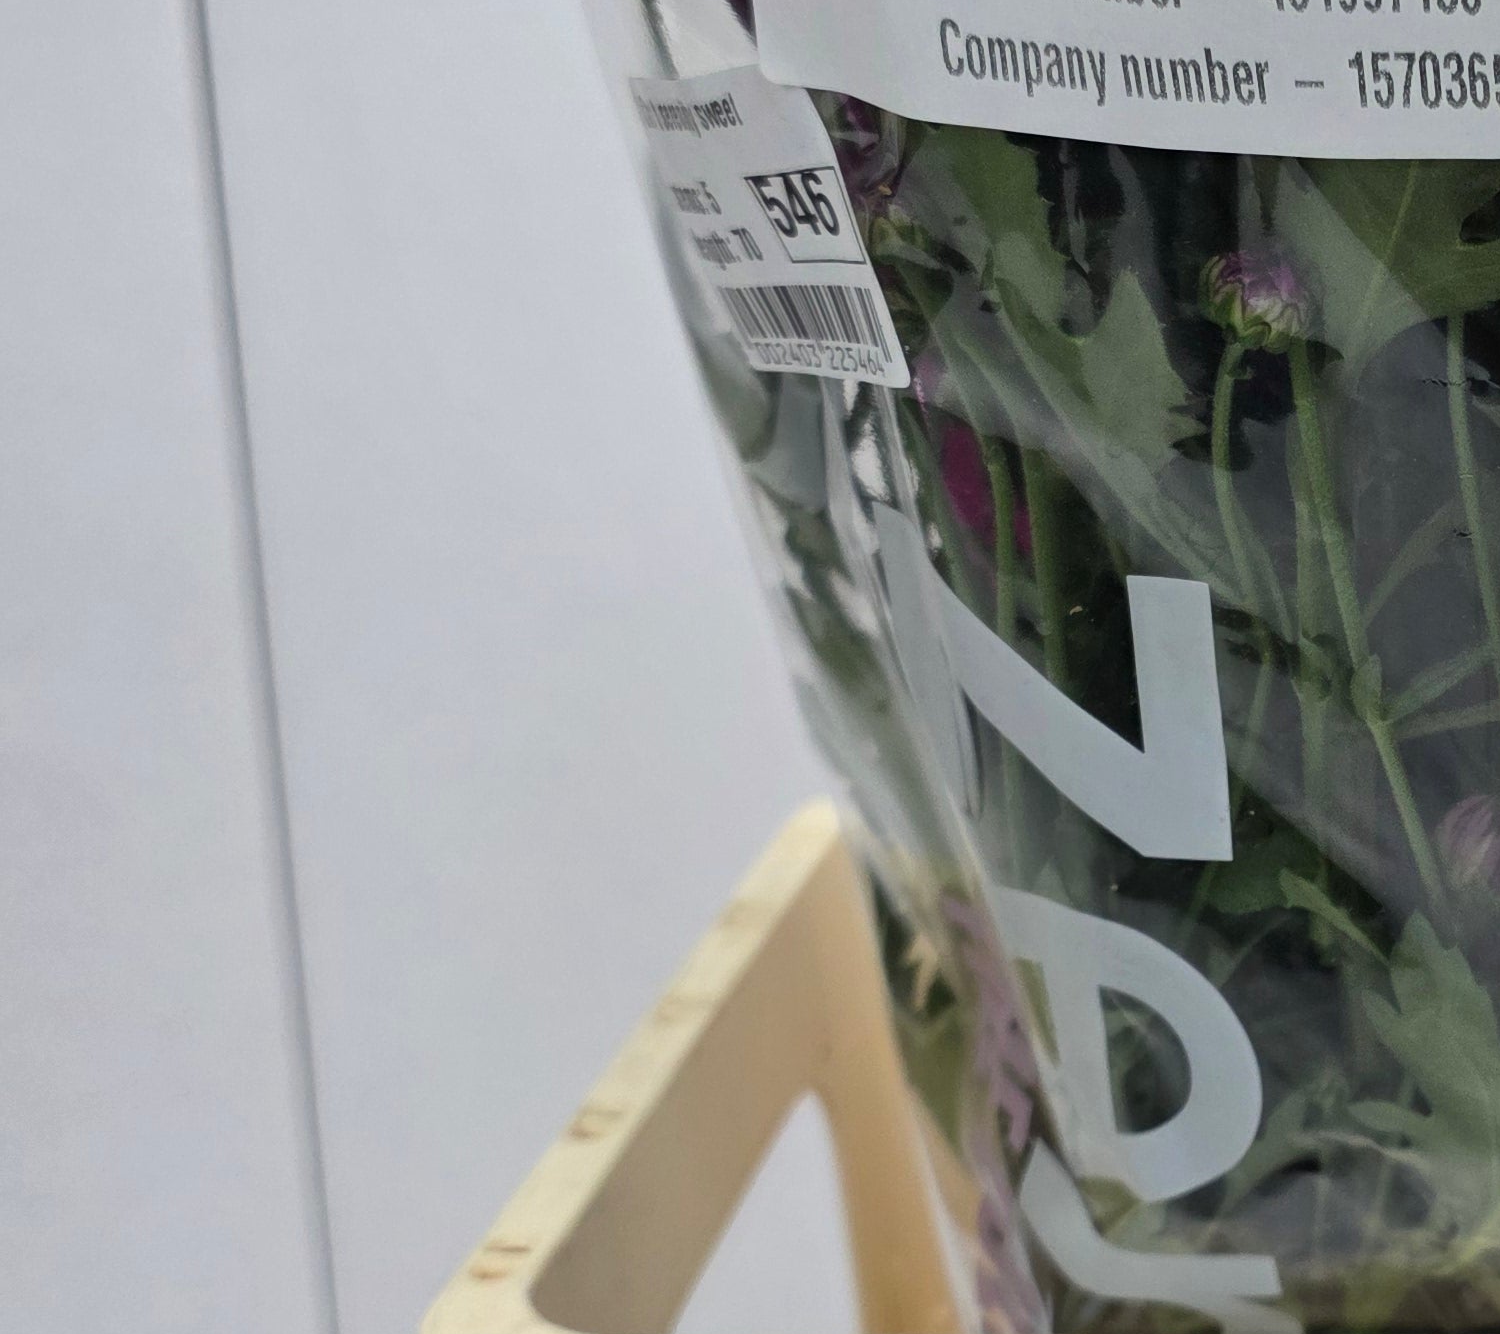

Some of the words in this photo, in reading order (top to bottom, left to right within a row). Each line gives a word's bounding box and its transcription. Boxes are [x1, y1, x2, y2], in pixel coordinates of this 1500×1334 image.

[940, 17, 1106, 106] Company
[1120, 47, 1269, 106] number
[752, 172, 841, 239] 546
